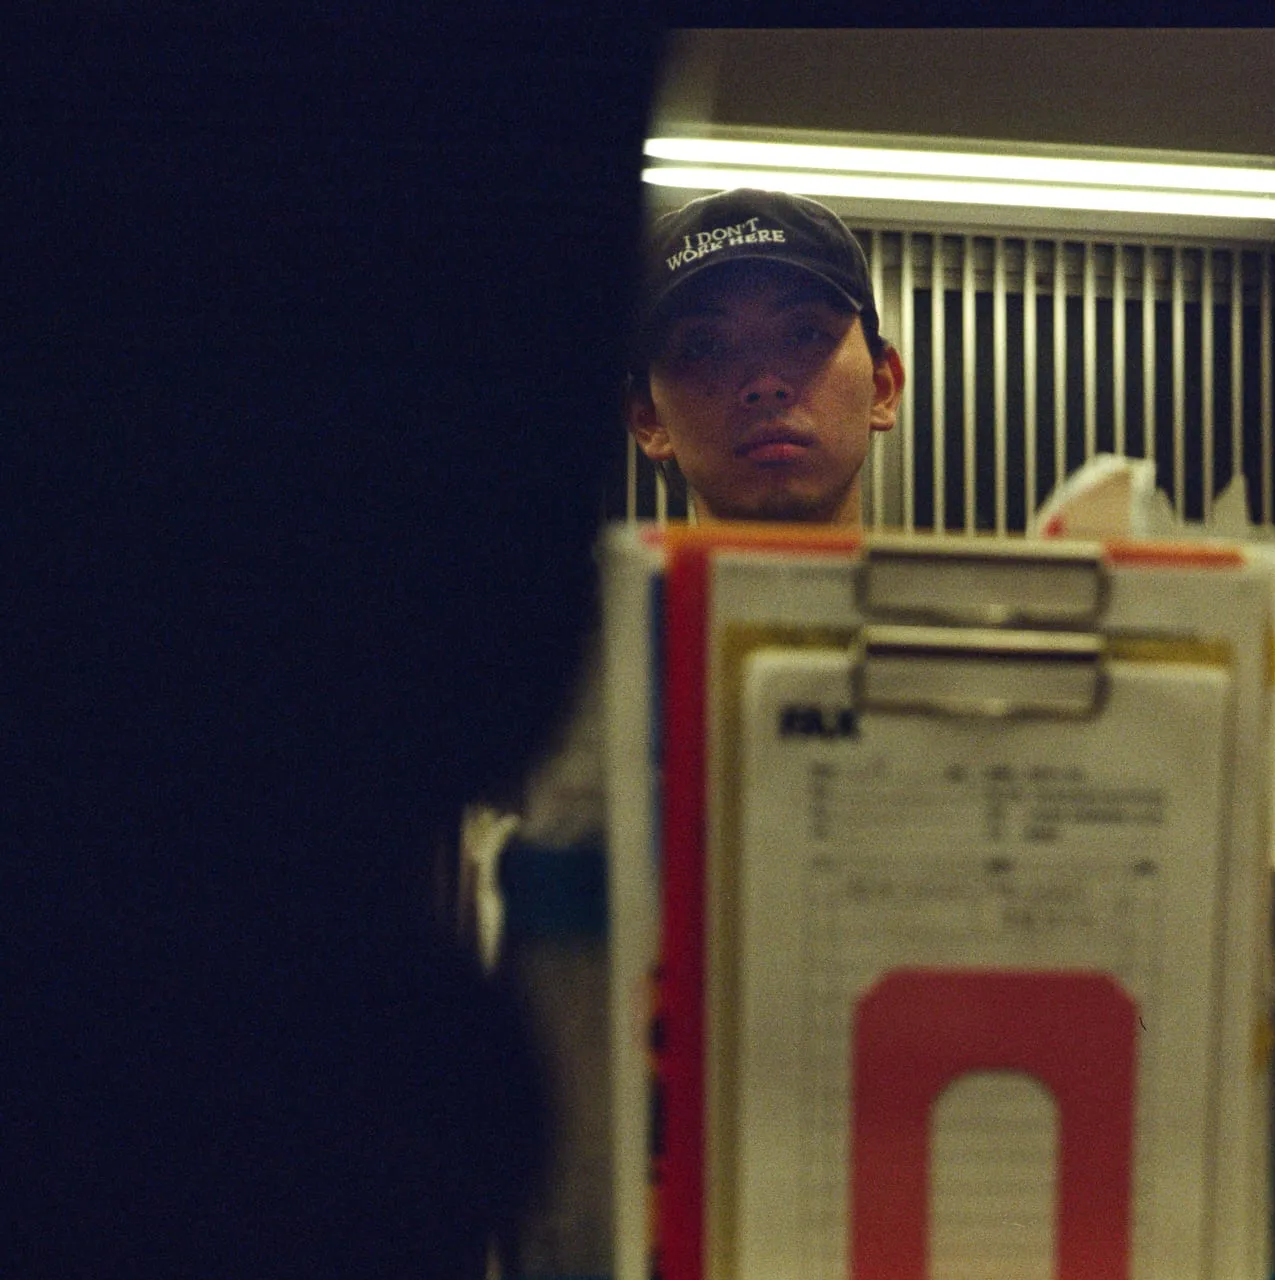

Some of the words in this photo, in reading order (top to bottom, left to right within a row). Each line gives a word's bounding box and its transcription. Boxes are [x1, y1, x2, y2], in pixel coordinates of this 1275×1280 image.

[666, 241, 723, 271] WORK
[729, 229, 786, 246] HERE
[683, 235, 692, 249] I
[696, 217, 759, 245] DON'T
